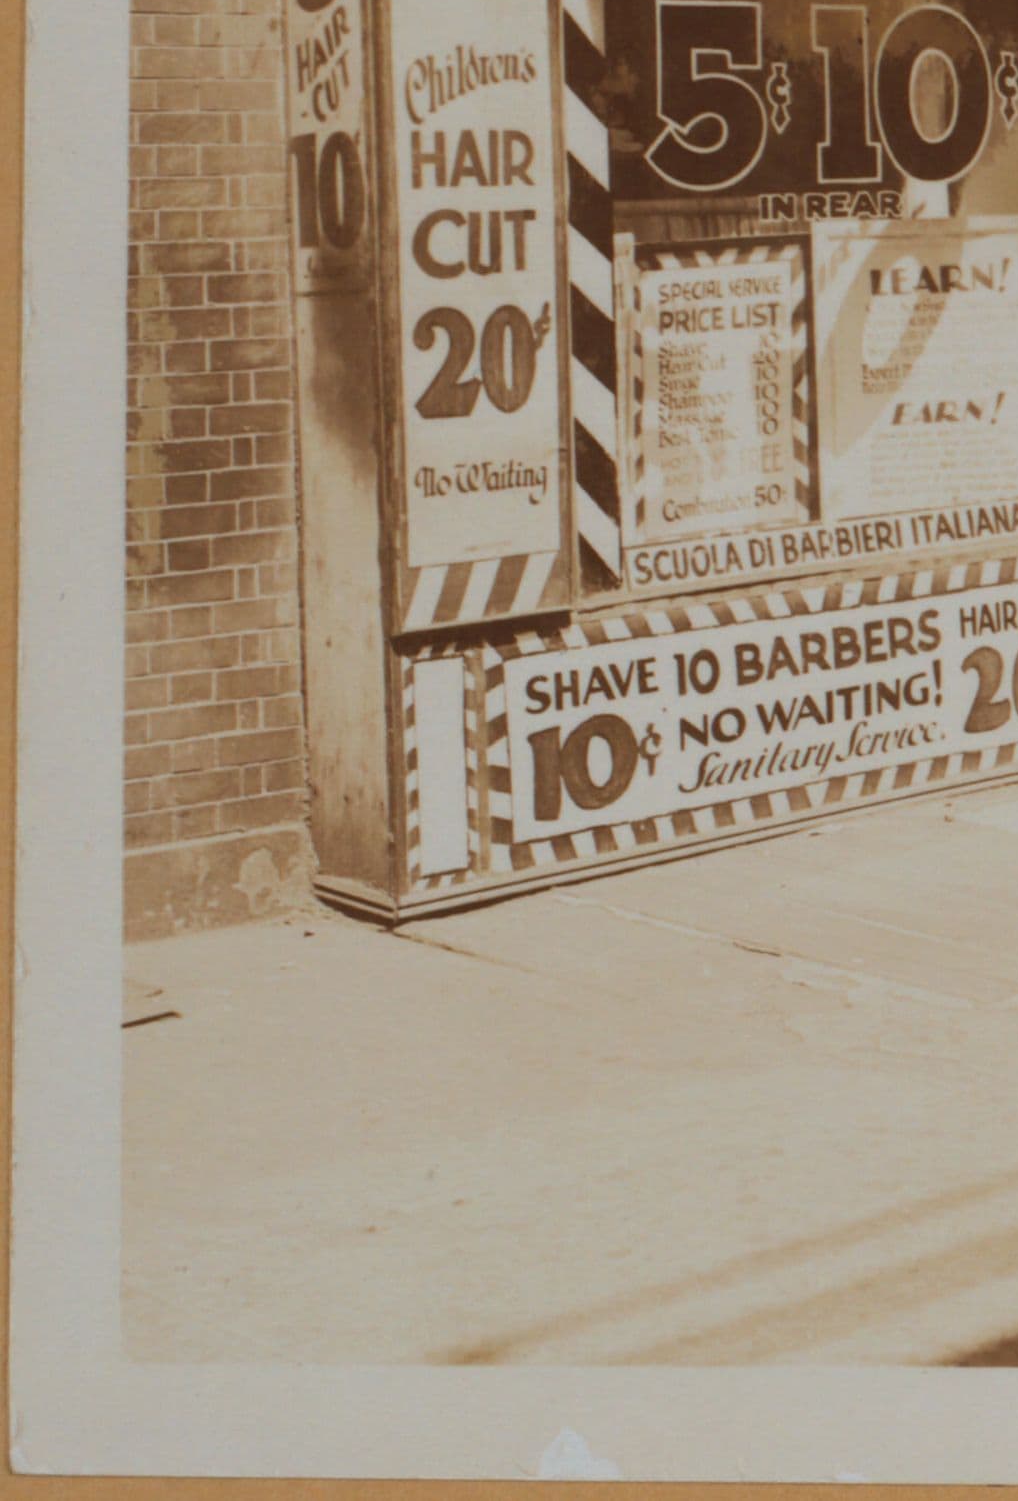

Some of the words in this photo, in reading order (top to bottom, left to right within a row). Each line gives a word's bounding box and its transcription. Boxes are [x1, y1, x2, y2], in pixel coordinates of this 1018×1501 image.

[297, 5, 351, 94] HAIR
[311, 50, 350, 123] CUT
[411, 129, 536, 190] HAIR
[759, 193, 795, 223] IN
[804, 189, 903, 221] REAR
[412, 208, 537, 280] CUT
[658, 279, 723, 306] SPECIAL
[728, 275, 783, 299] SERVICE
[869, 258, 1010, 296] LEARN!
[659, 306, 725, 336] PRICE
[731, 301, 781, 329] LIST
[413, 301, 551, 419] 20¢
[891, 391, 1006, 426] EARN!
[414, 464, 452, 499] No
[453, 460, 549, 506] Waiting
[634, 542, 743, 586] SCUOLA
[749, 538, 774, 567] DI
[780, 519, 902, 565] BARBIERI
[959, 598, 1018, 639] HAIR
[525, 656, 659, 715] SHAVE
[673, 651, 721, 696] 10
[734, 609, 942, 687] BARBERS
[679, 707, 747, 752] NO
[756, 659, 945, 737] WAITING!
[527, 713, 663, 822] 10¢
[678, 730, 836, 794] Sanitary
